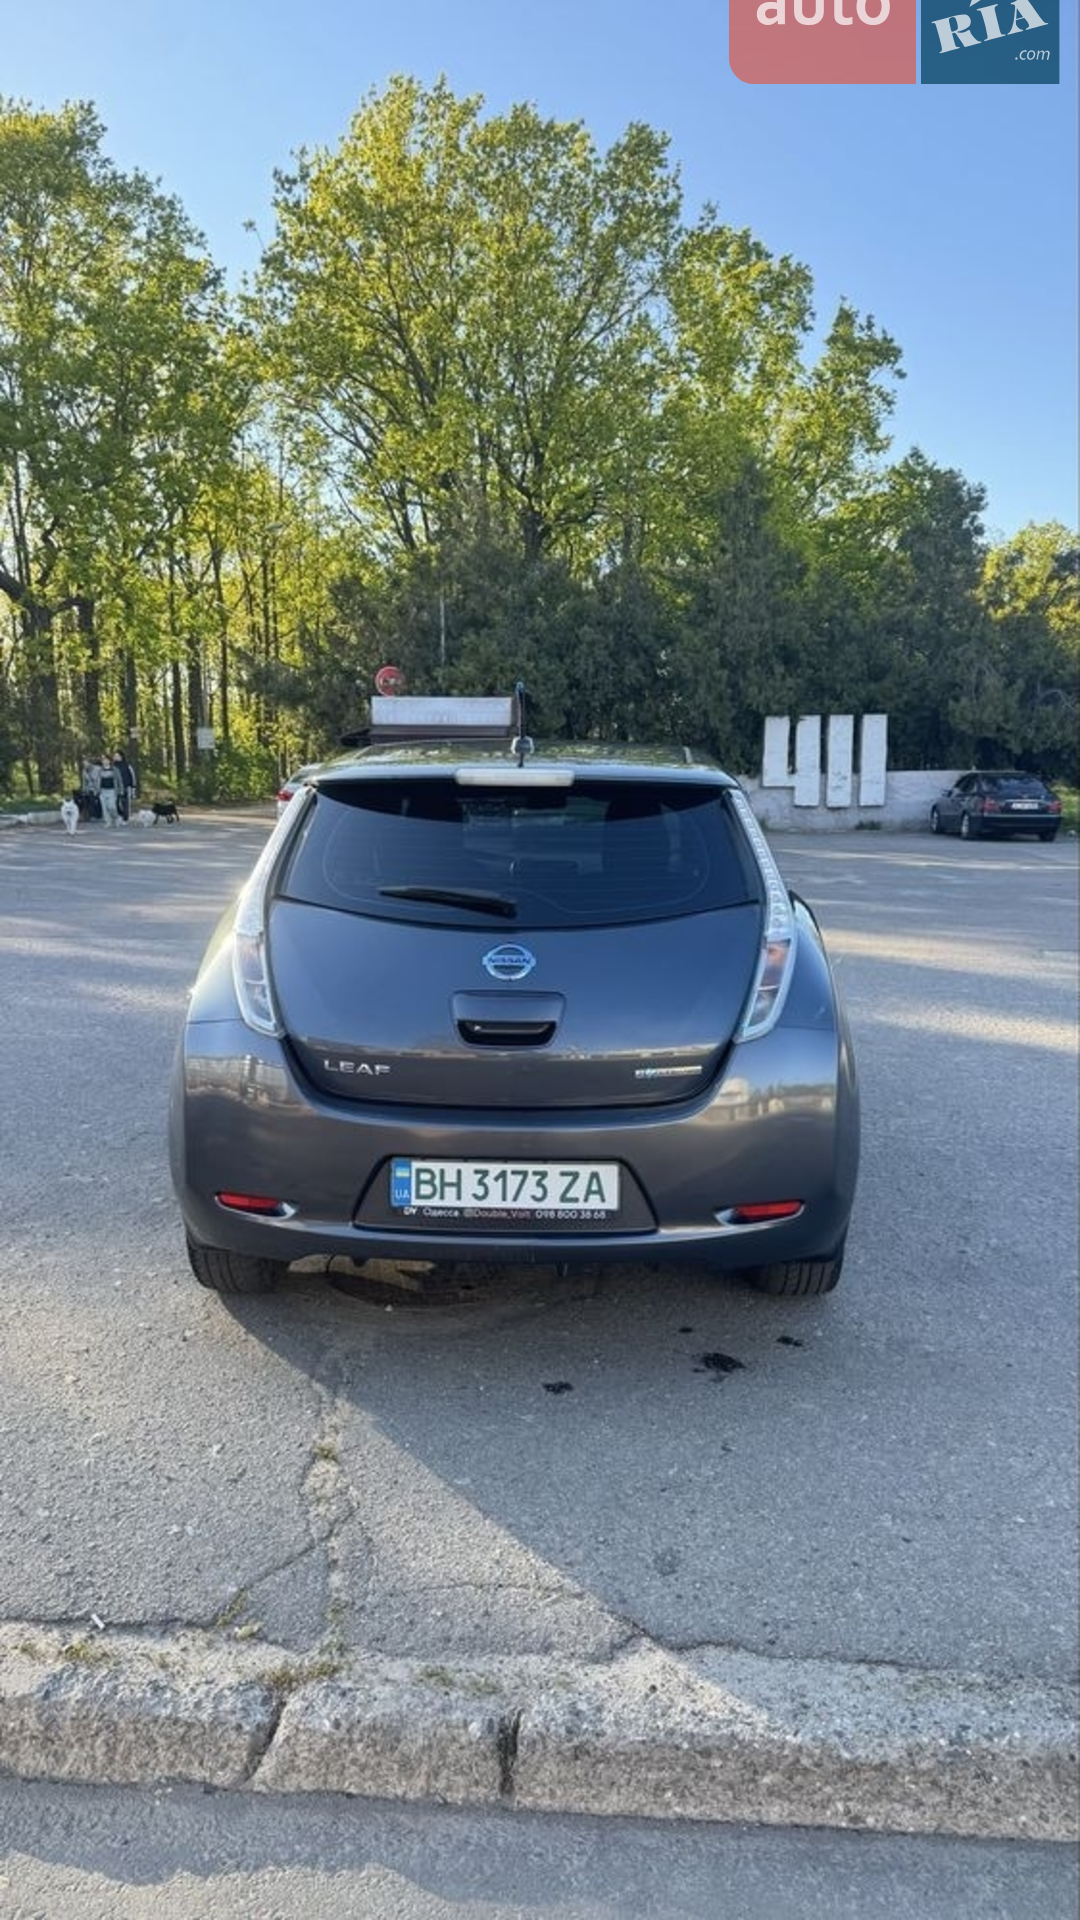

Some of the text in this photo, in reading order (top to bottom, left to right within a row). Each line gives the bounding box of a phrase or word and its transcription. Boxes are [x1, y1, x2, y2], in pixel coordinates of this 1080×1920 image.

[487, 955, 531, 965] NISSAN
[324, 1060, 391, 1075] LEAF
[414, 1167, 606, 1204] BH 3173 ZA
[395, 1188, 410, 1200] UA
[423, 1207, 459, 1218] Одесса
